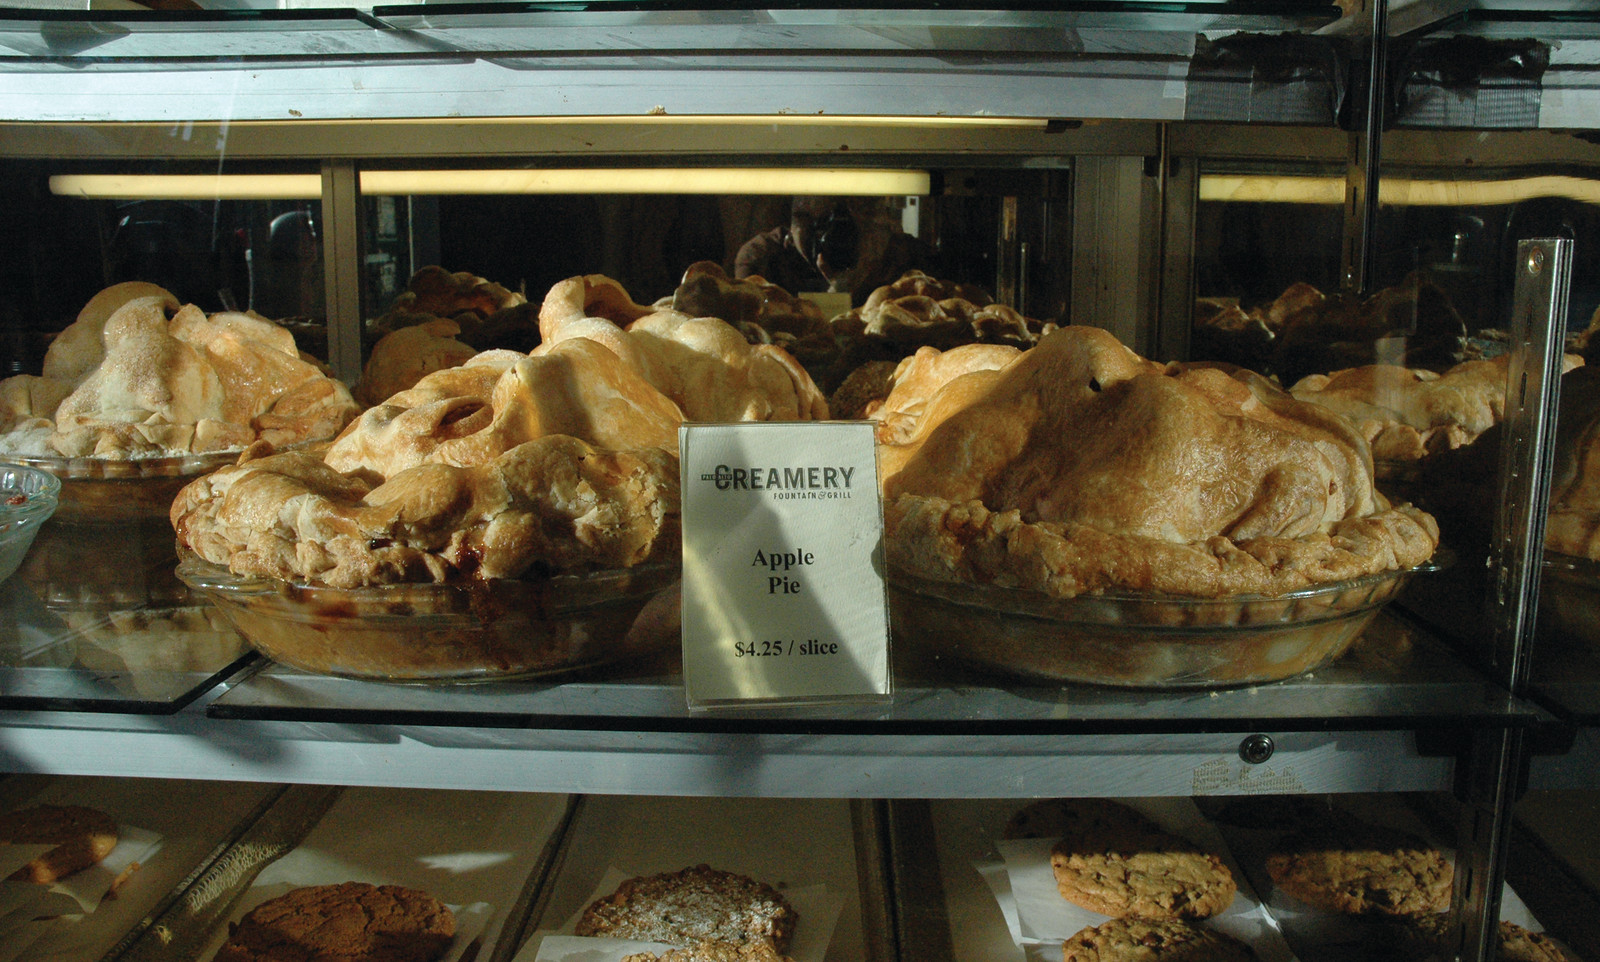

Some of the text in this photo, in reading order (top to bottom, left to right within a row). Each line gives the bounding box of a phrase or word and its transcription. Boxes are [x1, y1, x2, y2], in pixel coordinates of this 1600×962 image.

[714, 464, 855, 490] CREAMERY
[752, 548, 814, 571] Apple
[768, 577, 801, 594] Pie
[734, 641, 783, 657] $4.25
[799, 640, 838, 656] slice
